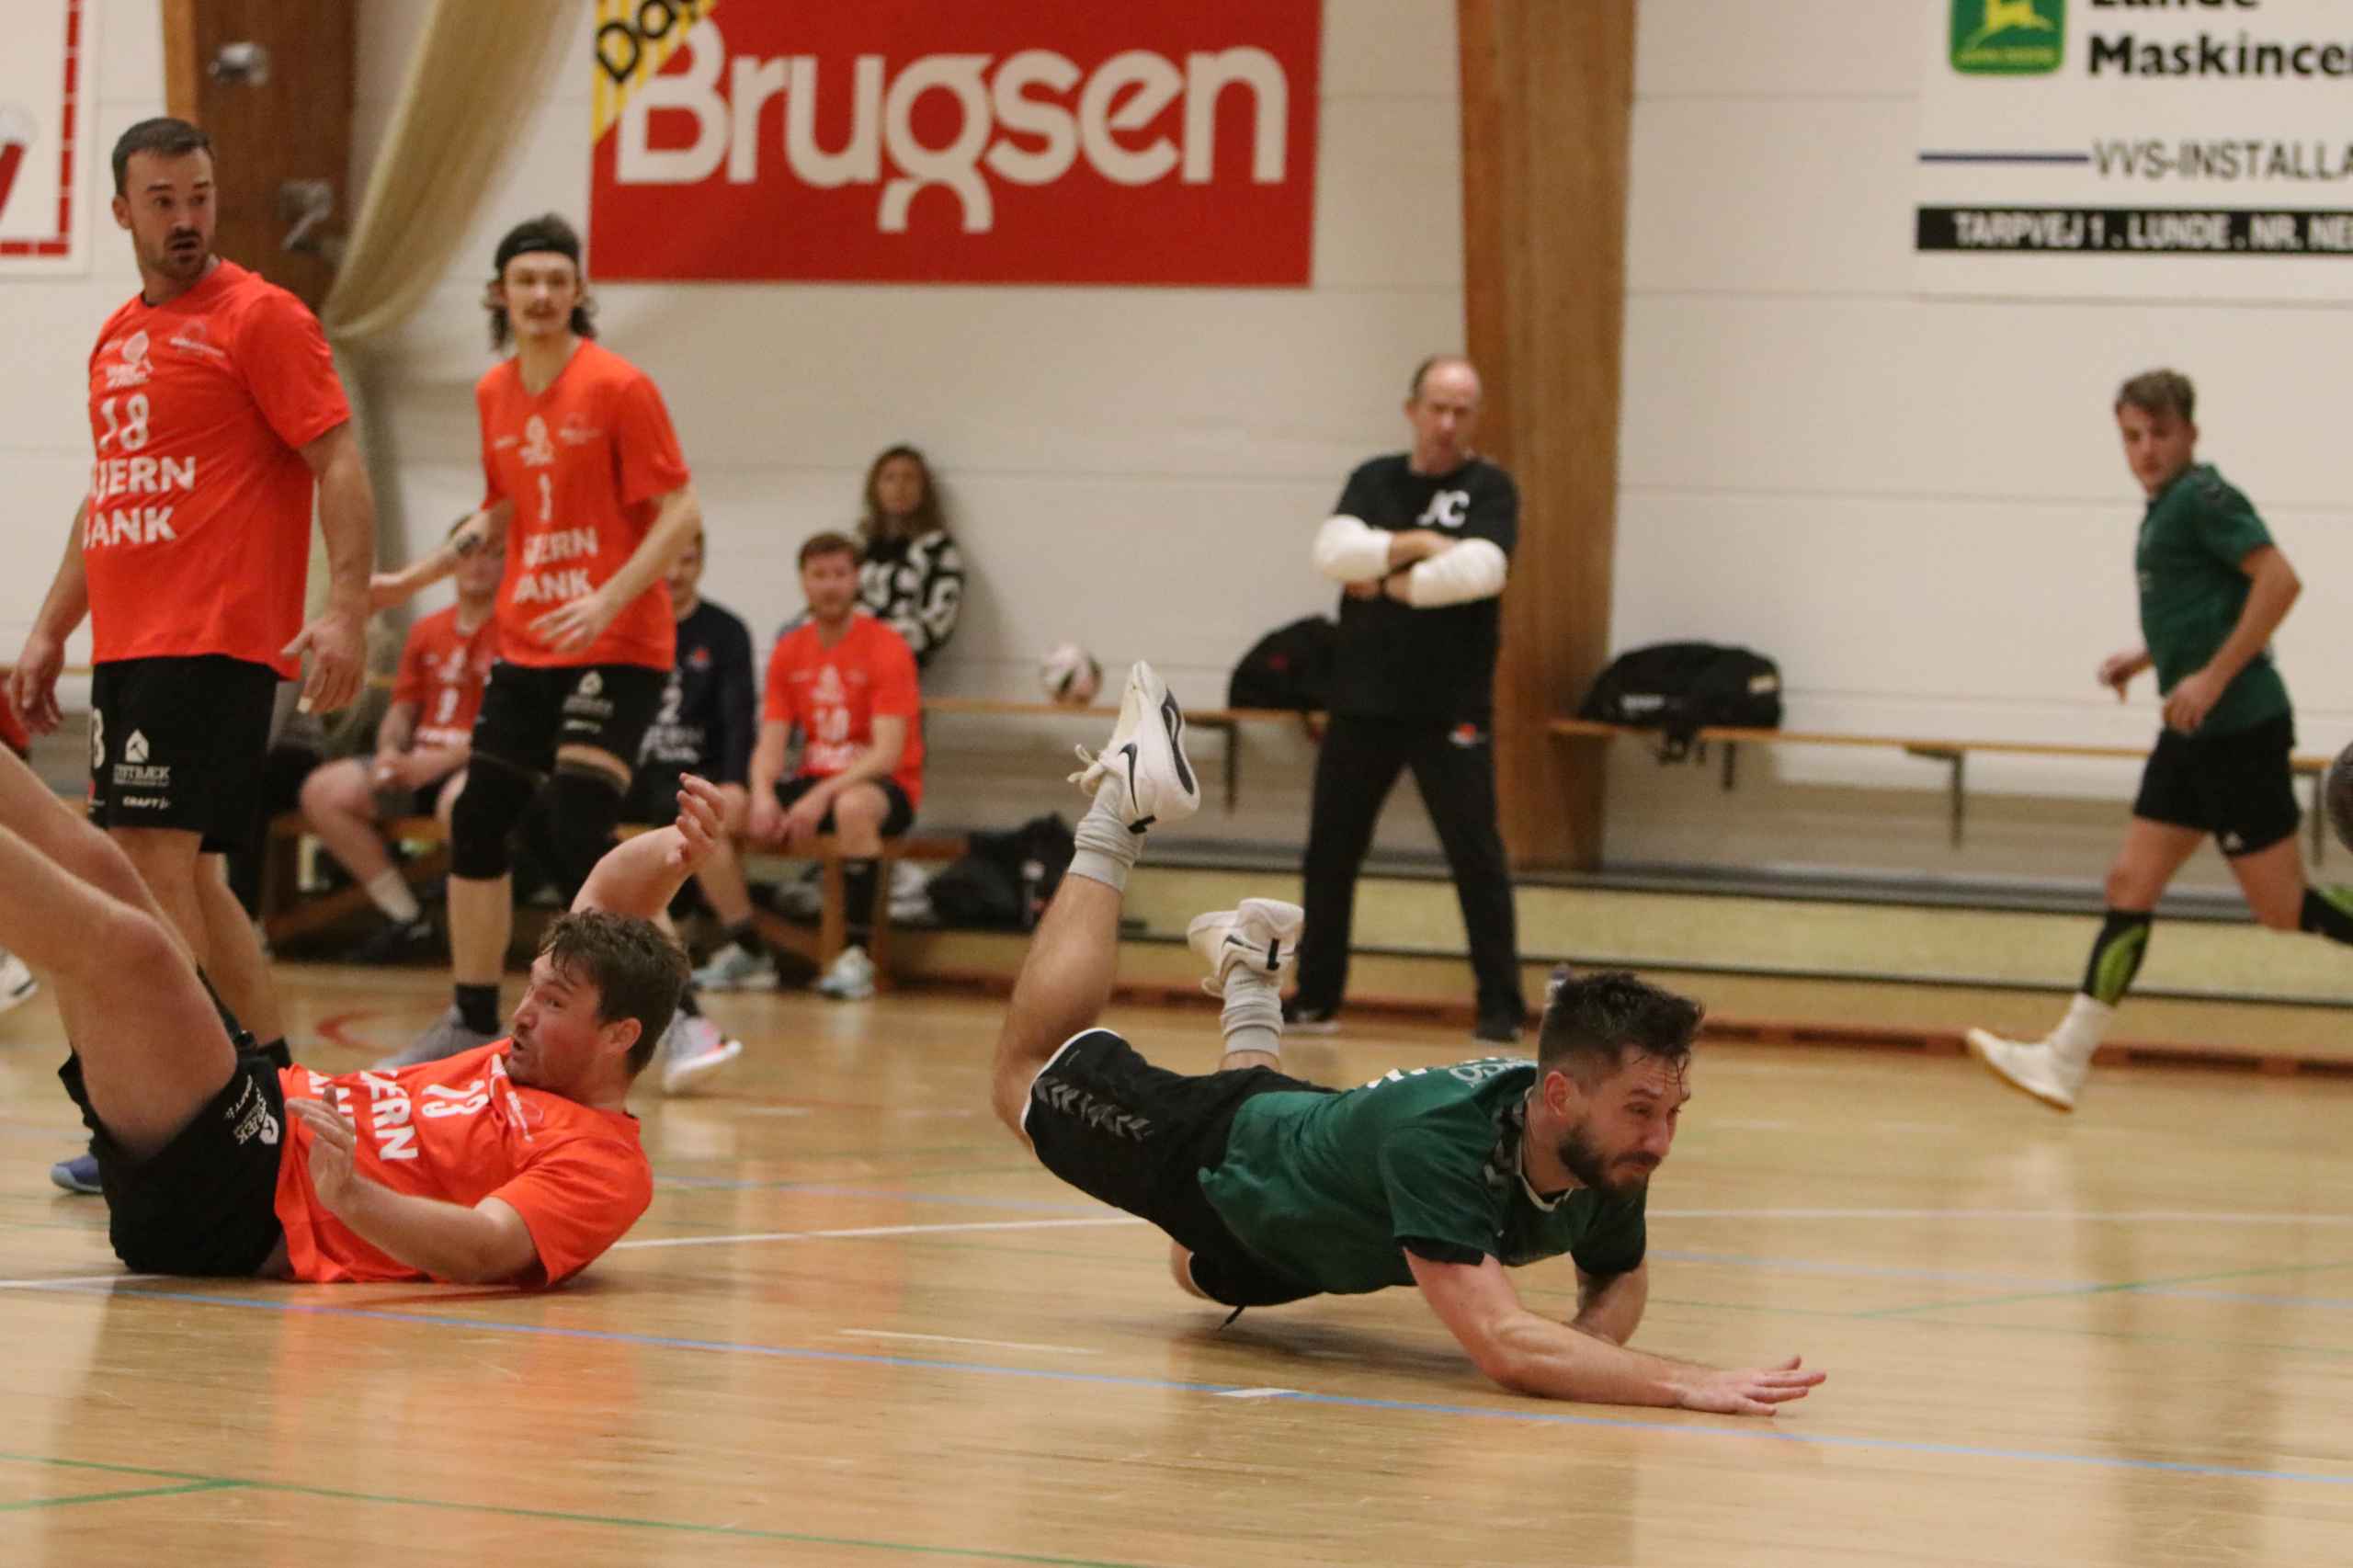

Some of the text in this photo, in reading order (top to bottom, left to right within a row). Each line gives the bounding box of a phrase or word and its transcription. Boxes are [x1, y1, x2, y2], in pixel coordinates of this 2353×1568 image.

[2088, 31, 2353, 77] Maskince
[615, 11, 1287, 233] Brugsen
[1954, 210, 2085, 248] TARPVEJ
[90, 456, 197, 506] JERN
[538, 472, 553, 526] 1
[84, 506, 176, 550] ANK
